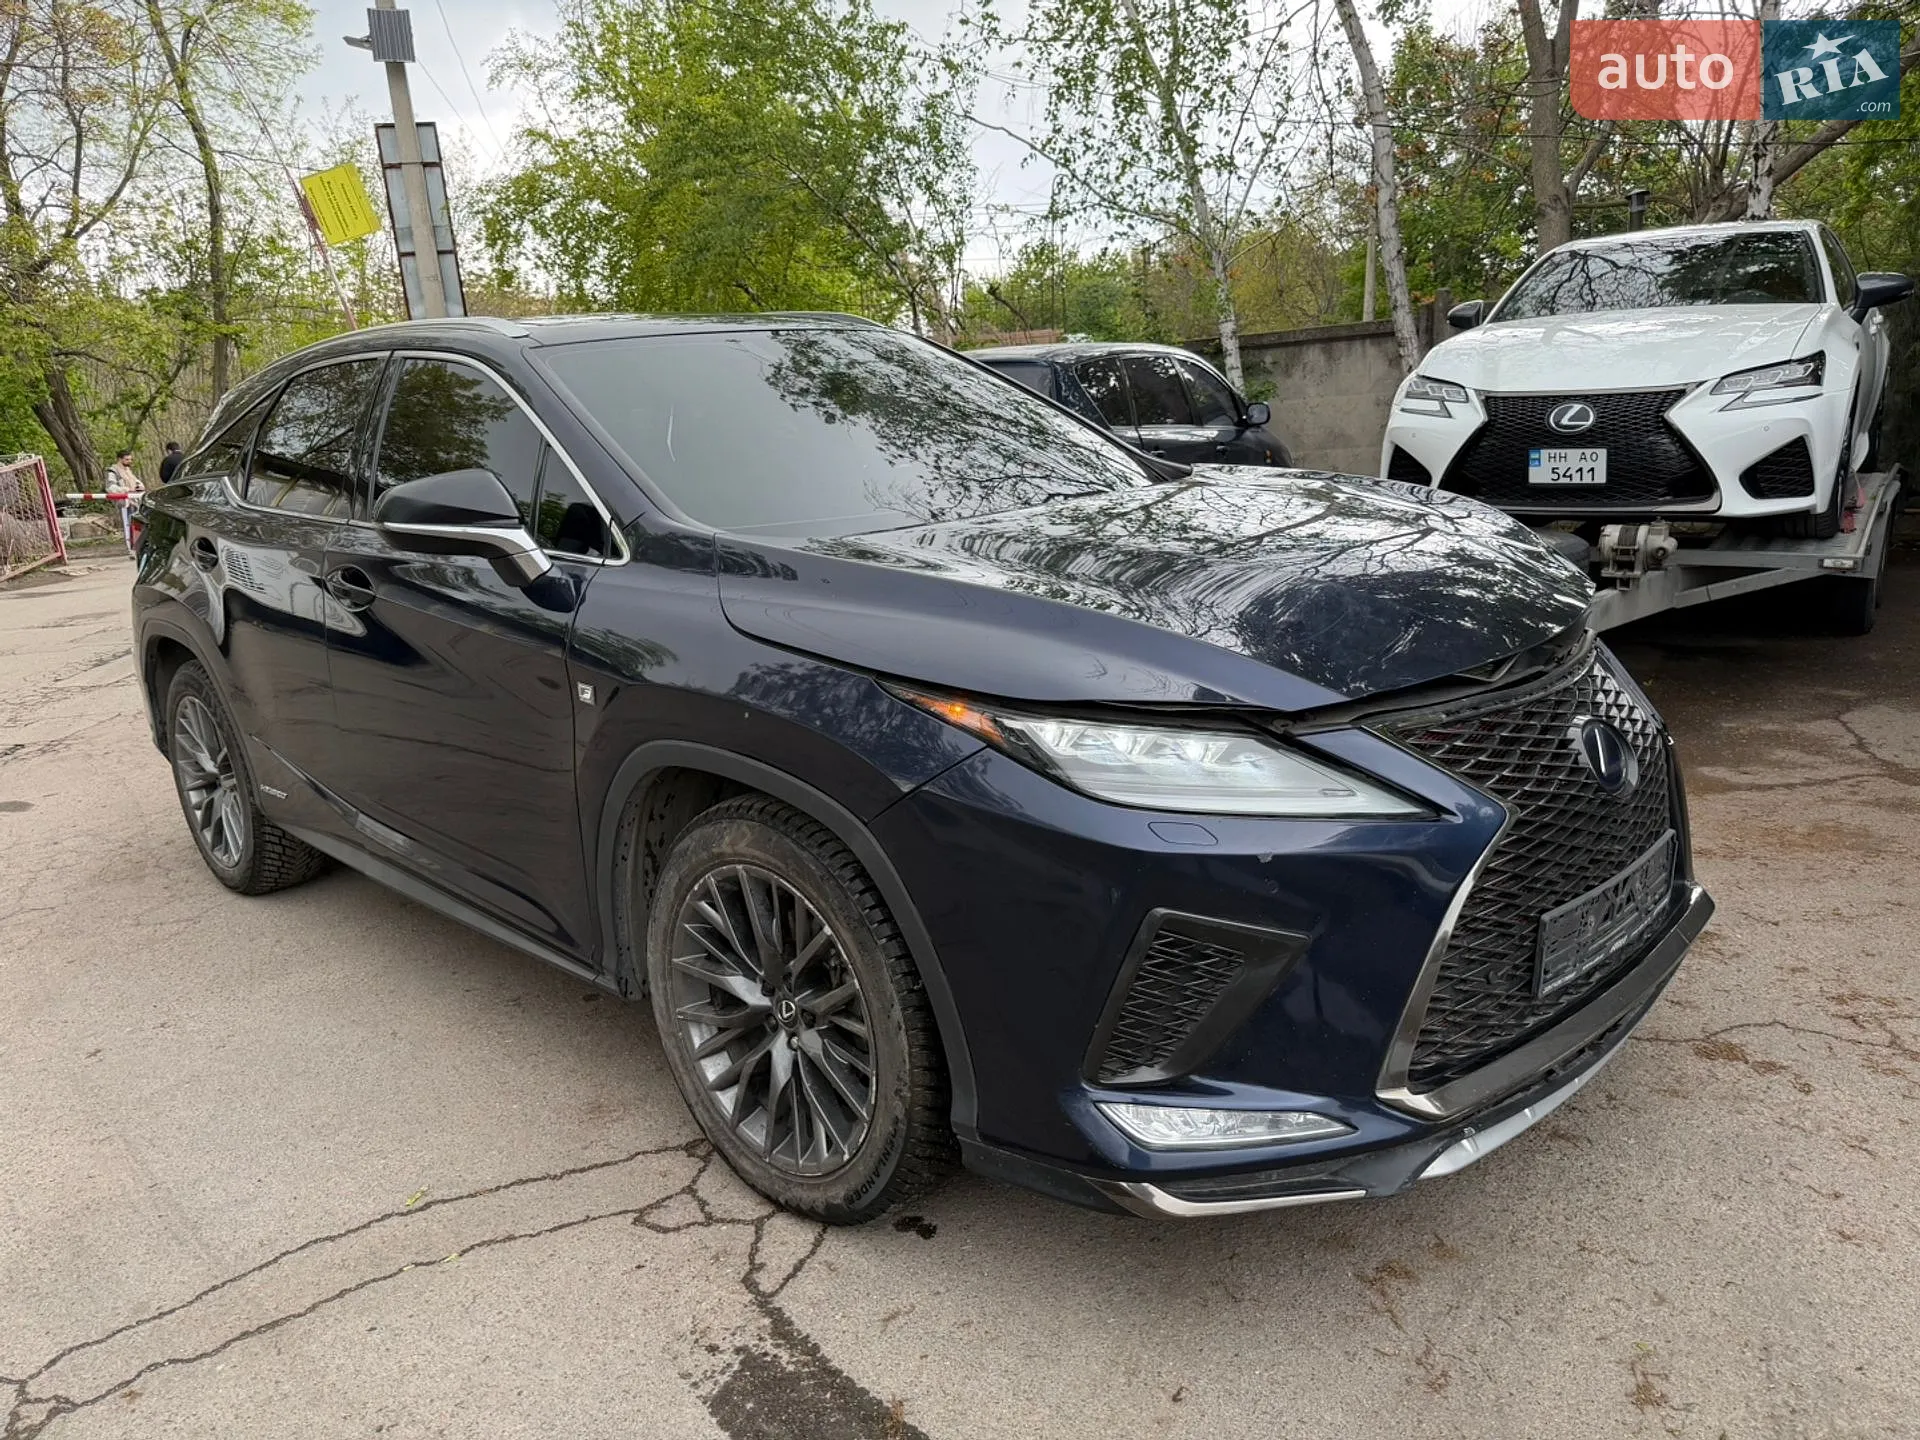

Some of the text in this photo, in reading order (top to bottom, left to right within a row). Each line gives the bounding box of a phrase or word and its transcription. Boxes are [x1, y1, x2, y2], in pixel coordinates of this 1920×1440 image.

[1547, 451, 1568, 463] HH
[1578, 451, 1599, 463] AO
[1550, 466, 1595, 481] 5411
